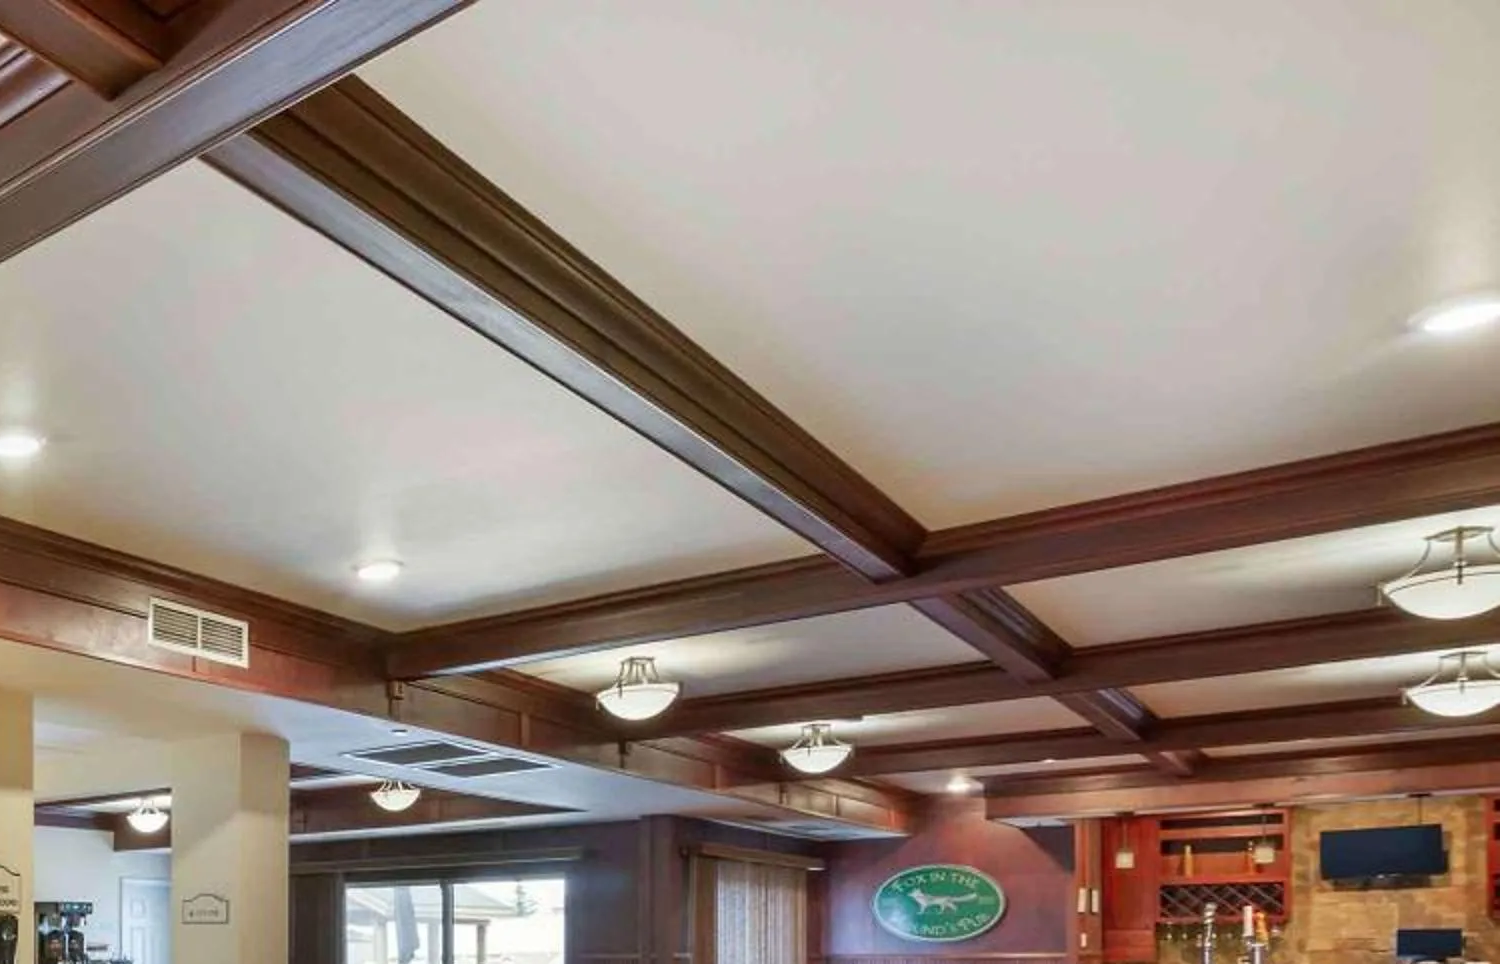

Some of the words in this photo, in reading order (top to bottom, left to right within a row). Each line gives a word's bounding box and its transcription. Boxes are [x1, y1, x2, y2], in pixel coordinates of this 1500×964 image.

[891, 874, 928, 893] FOX
[930, 872, 947, 881] IN
[950, 873, 981, 889] THE
